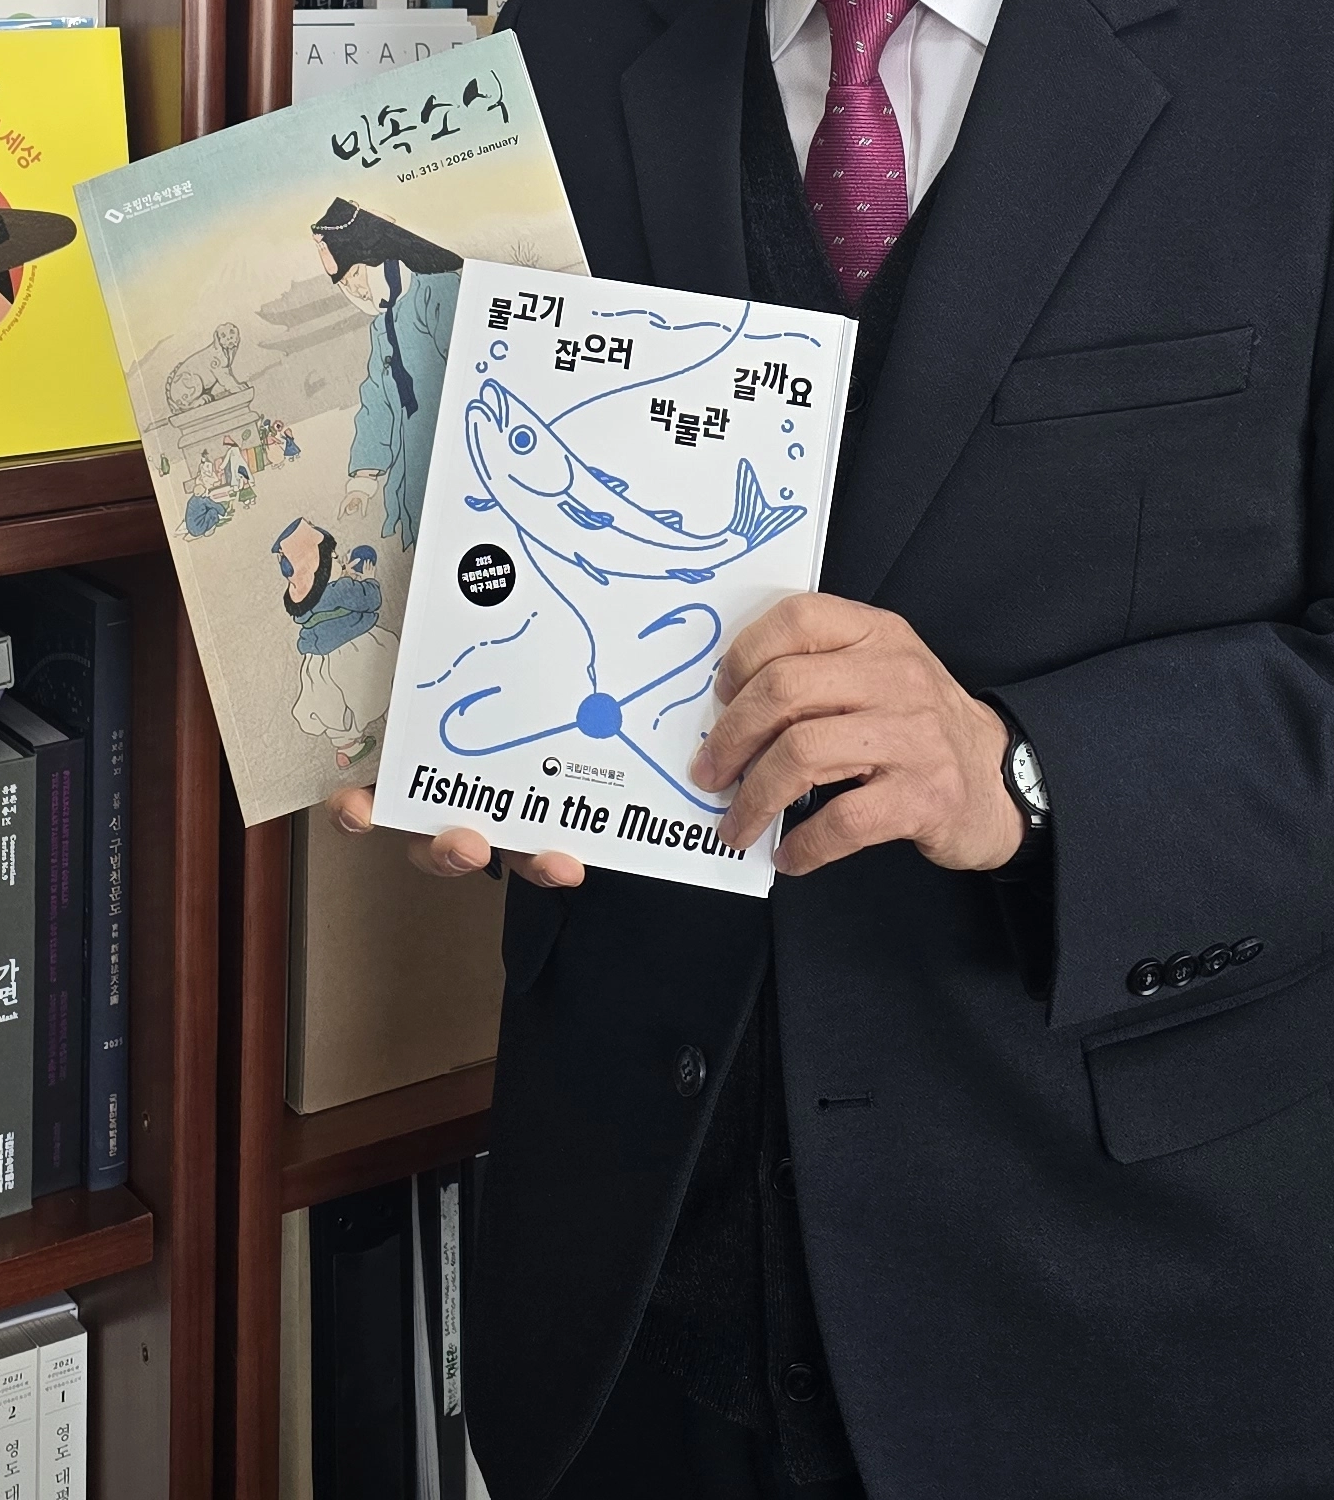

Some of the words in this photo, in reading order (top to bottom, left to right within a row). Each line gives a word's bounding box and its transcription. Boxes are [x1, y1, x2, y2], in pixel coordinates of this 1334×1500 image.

[331, 70, 510, 169] 민속소식
[0, 126, 42, 169] 세상
[396, 170, 419, 184] Vol.
[418, 162, 440, 179] 313
[445, 150, 475, 169] 2026
[475, 133, 520, 157] January
[122, 180, 194, 216] 국립민속박물관
[487, 291, 565, 331] 물고기
[554, 334, 634, 372] 잡으러
[733, 362, 813, 409] 갈까요
[649, 397, 731, 448] 박물관
[565, 760, 626, 781] 국립민속박물관
[407, 764, 515, 823] Fishing
[520, 786, 551, 824] in
[560, 795, 610, 834] the
[2, 1372, 23, 1386] 2021
[53, 1358, 74, 1371] 2021
